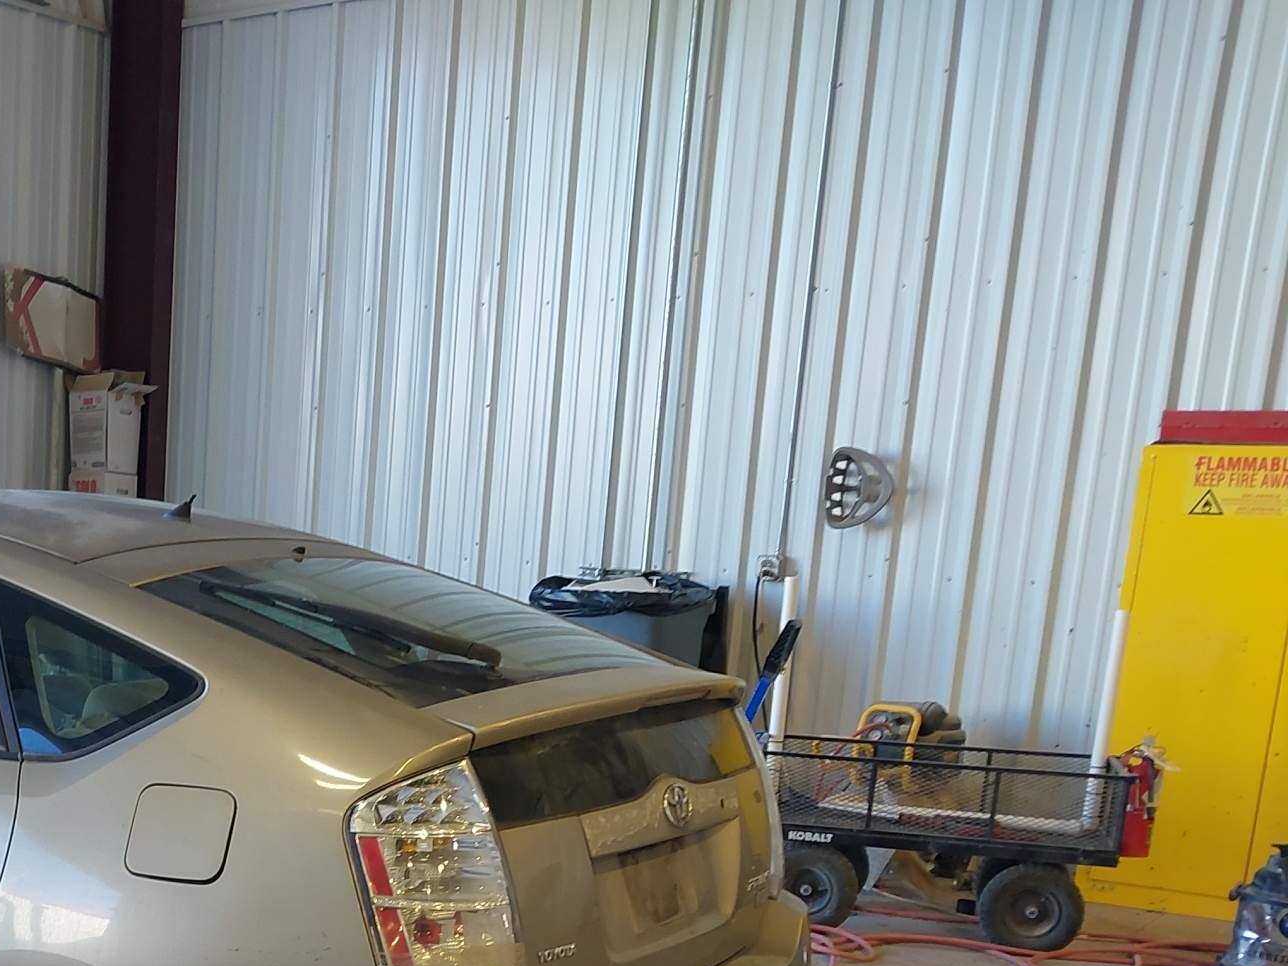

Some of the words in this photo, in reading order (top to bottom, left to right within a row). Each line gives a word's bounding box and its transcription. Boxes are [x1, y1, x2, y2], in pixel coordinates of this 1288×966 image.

[1193, 472, 1225, 488] KEEP
[1228, 473, 1257, 488] FIRE
[788, 830, 834, 843] KOBALT
